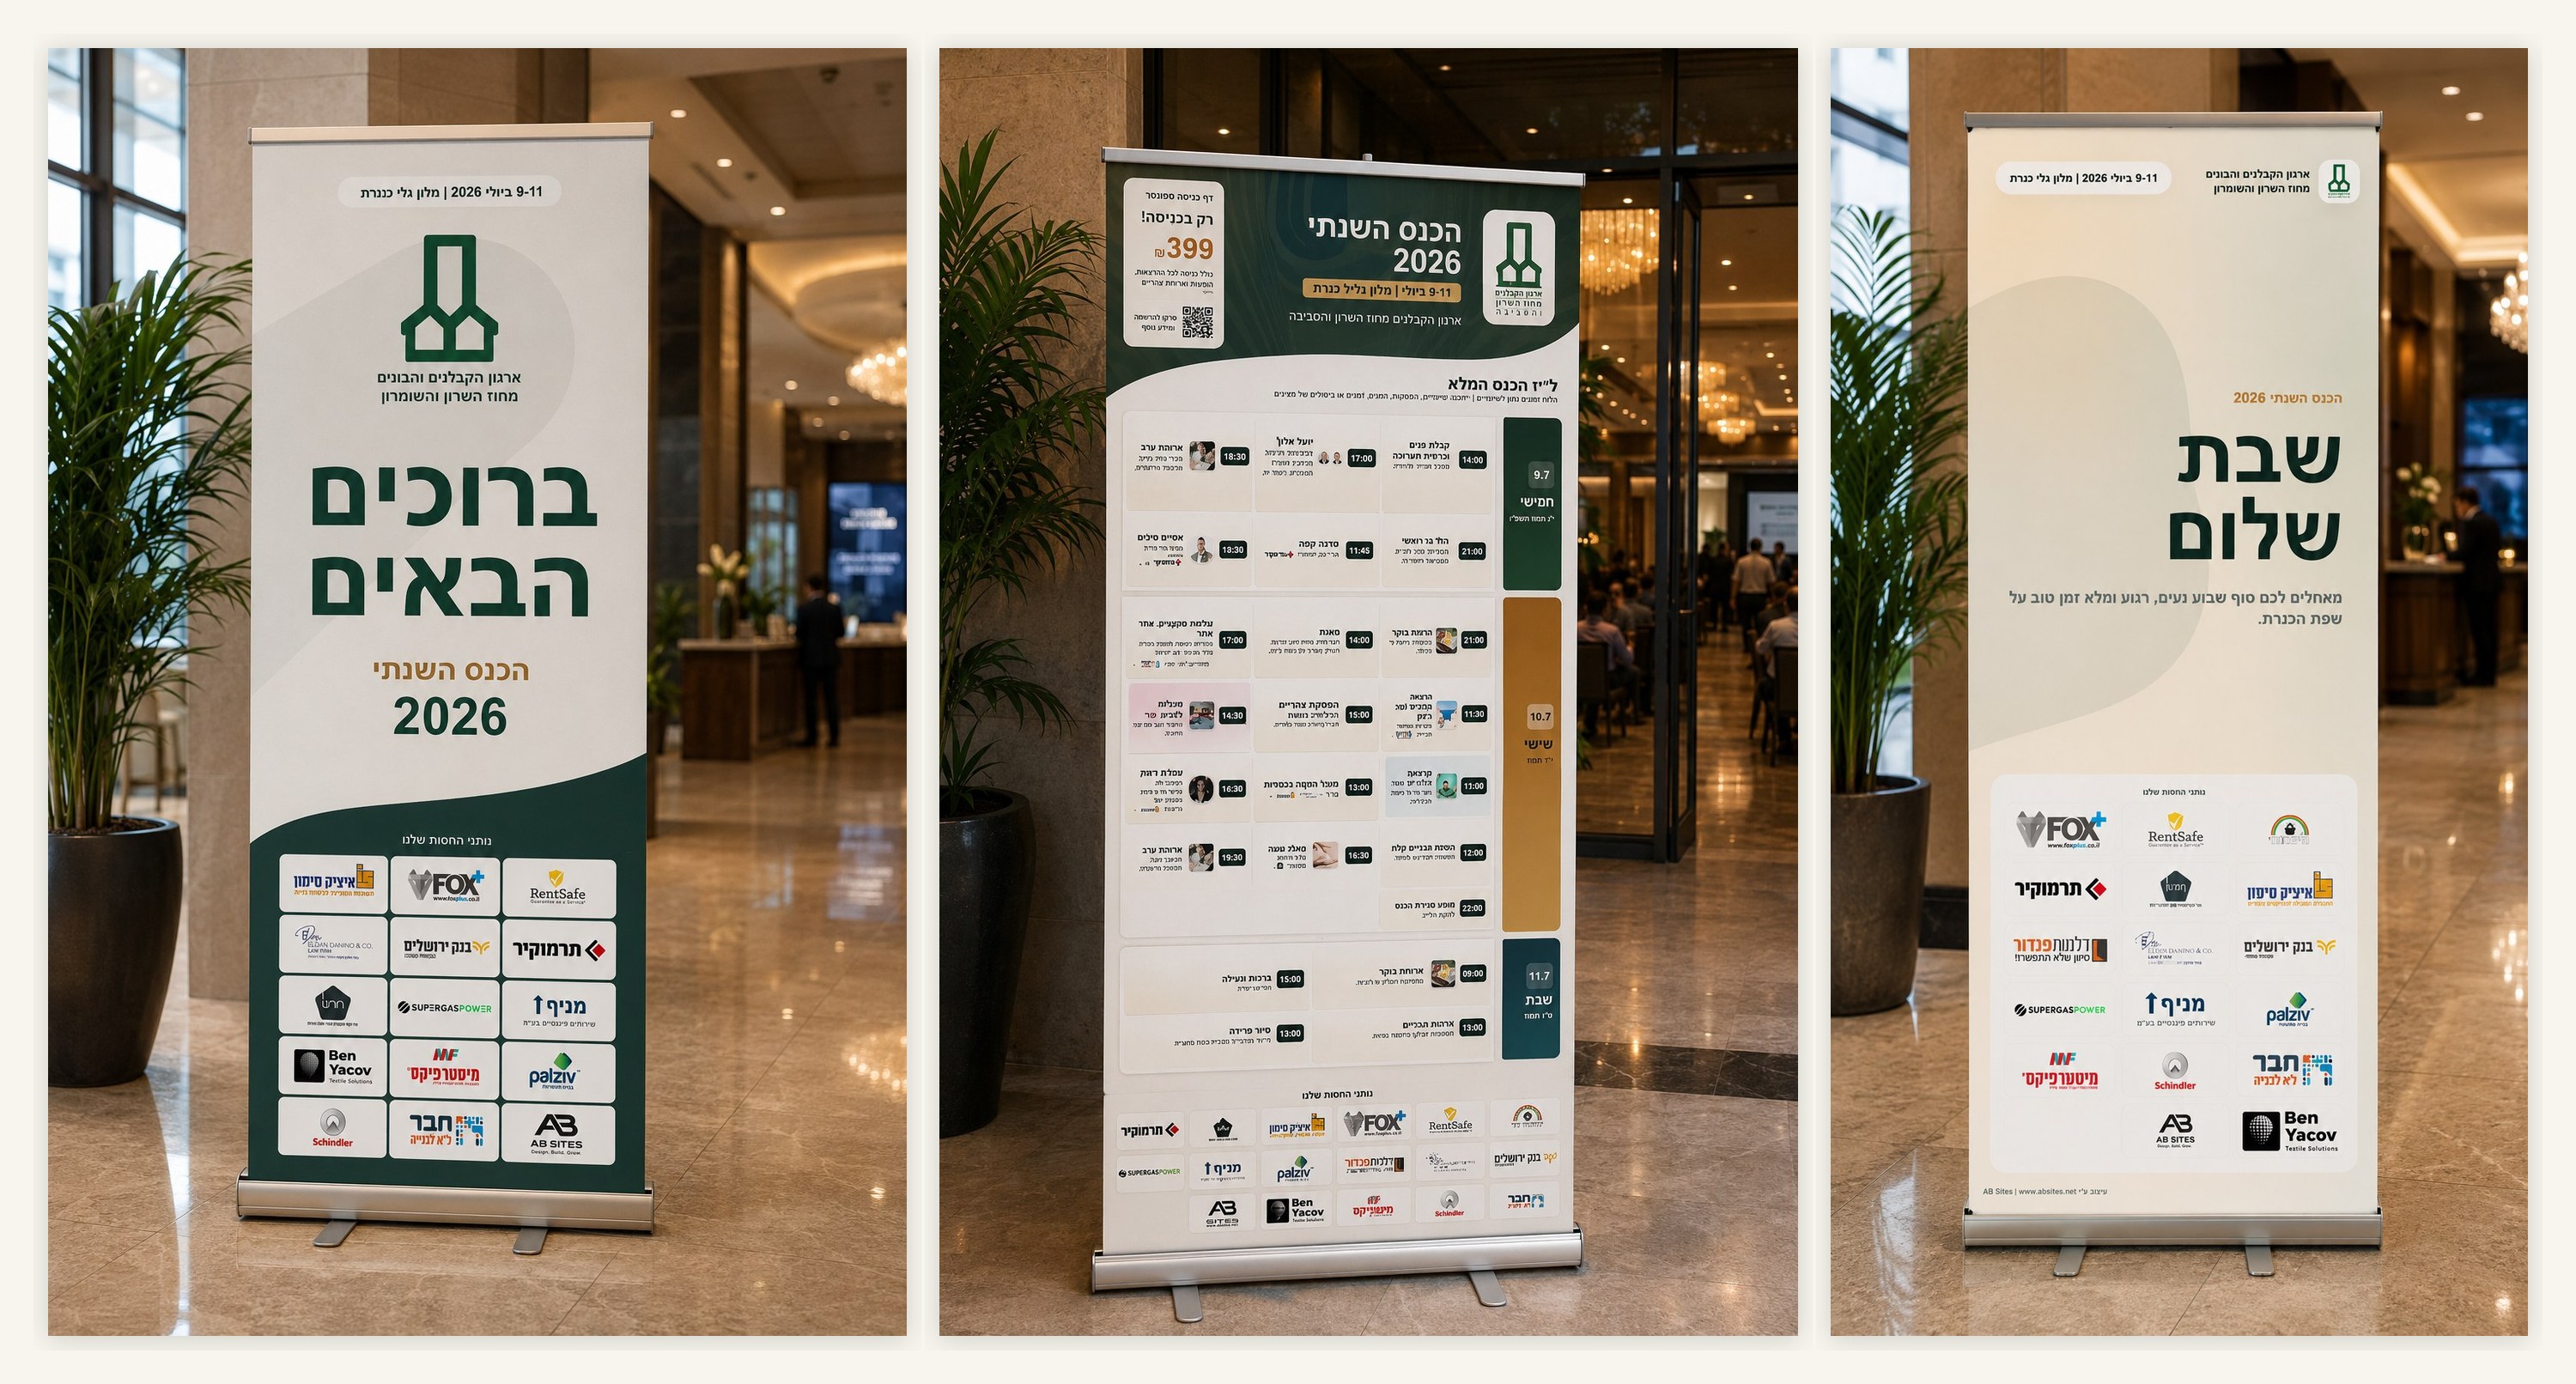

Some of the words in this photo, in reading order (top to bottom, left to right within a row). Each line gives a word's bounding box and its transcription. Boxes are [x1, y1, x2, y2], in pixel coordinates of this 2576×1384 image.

[2009, 174, 2033, 183] כנרת
[2036, 173, 2050, 183] גלי
[2053, 173, 2073, 185] מלון
[2081, 173, 2108, 183] 2026
[2110, 173, 2133, 183] ביולי
[2135, 173, 2157, 183] 9-11
[2242, 168, 2283, 181] הקבלנים
[2286, 171, 2311, 181] ארגון
[397, 186, 413, 198] גלי
[416, 186, 440, 201] מלון
[451, 185, 482, 198] 2026
[485, 185, 513, 197] ביולי
[516, 185, 542, 197] 9-11
[2214, 185, 2255, 196] והשומרון
[2257, 185, 2285, 196] השרון
[2287, 185, 2311, 193] מחוז
[1145, 191, 1176, 200] ספונסר
[1176, 193, 1201, 202] כניסה
[1202, 194, 1214, 203] דף
[1196, 215, 1213, 228] רק
[1308, 216, 1389, 240] השנתי
[1399, 221, 1461, 243] הכנס
[1394, 247, 1461, 275] 2026
[1370, 283, 1392, 298] מלון
[1401, 285, 1426, 297] ביולי
[1429, 287, 1451, 298] 9-11
[1495, 300, 1521, 308] השרון
[1289, 312, 1331, 322] והסביבה
[1334, 313, 1364, 325] השרון
[1366, 314, 1389, 324] מחוז
[1393, 313, 1435, 327] הקבלנים
[377, 373, 424, 384] והבונים
[428, 370, 484, 386] הקבלנים
[488, 373, 521, 386] ארגון
[1448, 376, 1488, 391] המלא
[1492, 379, 1528, 392] הכנס
[381, 392, 439, 405] והשומרון
[444, 392, 483, 405] השרון
[487, 392, 519, 402] מחוז
[2233, 392, 2266, 404] 2026
[2269, 394, 2308, 404] השנתי
[2312, 394, 2342, 404] הכנס
[1224, 452, 1247, 461] 18:30
[1351, 454, 1373, 463] 17:00
[1461, 456, 1484, 464] 14:00
[2177, 435, 2341, 484] שבת
[1534, 470, 1550, 480] 9.7
[312, 465, 598, 527] ברוכים
[1520, 497, 1554, 507] חמישי
[2169, 495, 2341, 561] שלום
[1461, 547, 1483, 555] 21:00
[312, 556, 589, 617] הבאים
[2008, 590, 2027, 604] על
[2030, 590, 2055, 604] טוב
[2059, 590, 2081, 607] זמן
[2084, 590, 2117, 604] ומלא
[2120, 592, 2149, 604] רגוע
[2154, 591, 2188, 606] נעים,
[2191, 590, 2227, 604] שבוע
[2231, 590, 2256, 607] סוף
[2259, 590, 2286, 604] לכם
[2290, 590, 2342, 604] מאחלים
[2257, 614, 2306, 625] הכנרת.
[2310, 614, 2342, 625] שפת
[374, 661, 456, 681] השנתי
[465, 662, 529, 682] הכנס
[393, 695, 507, 737] 2026
[1222, 711, 1243, 719] 14:30
[1530, 712, 1552, 721] 10.7
[1524, 739, 1553, 750] שישי
[1221, 785, 1243, 793] 16:30
[2142, 787, 2160, 796] שלנו
[402, 834, 426, 845] שלנו
[428, 836, 464, 846] החסות
[467, 837, 492, 846] נותני
[2148, 830, 2204, 842] RentSafe
[1221, 853, 1243, 862] 19:30
[1462, 848, 1484, 857] 12:00
[325, 876, 355, 889] איציק
[530, 887, 586, 901] RentSafe
[2014, 881, 2082, 900] תרמוקיר
[1461, 904, 1483, 913] 22:00
[404, 938, 449, 953] ירושלים
[451, 941, 472, 956] בנק
[512, 942, 581, 961] תרמוקיר
[2244, 938, 2289, 953] ירושלים
[2293, 941, 2314, 956] בנק
[1462, 969, 1484, 978] 09:00
[1528, 971, 1551, 981] 11.7
[1524, 995, 1553, 1005] שבת
[546, 999, 586, 1018] מניף
[2027, 1005, 2105, 1014] SUPERGASPOWER
[2160, 997, 2205, 1017] מניף
[2266, 1005, 2312, 1027] palziv
[328, 1049, 356, 1062] Ben
[329, 1064, 373, 1077] Yacov
[529, 1065, 577, 1090] palziv
[2154, 1080, 2196, 1090] Schindler
[1302, 1090, 1321, 1100] שלנו
[1323, 1090, 1352, 1099] החסות
[409, 1114, 453, 1132] חבר
[2284, 1111, 2318, 1125] Ben
[1428, 1118, 1473, 1132] RentSafe
[1121, 1126, 1163, 1138] תרמוקיר
[2285, 1127, 2337, 1142] Yacov
[313, 1138, 354, 1147] Schindler
[530, 1139, 548, 1148] AB
[550, 1139, 583, 1149] SITES
[2170, 1135, 2196, 1144] SITES
[1494, 1153, 1526, 1165] ירושלים
[1527, 1153, 1541, 1164] בנק
[1213, 1161, 1242, 1175] מניף
[1277, 1164, 1312, 1183] palziv
[1291, 1198, 1314, 1208] Ben
[1507, 1194, 1531, 1205] חבר
[1291, 1205, 1325, 1217] Yacov
[1434, 1207, 1465, 1217] Schindler
